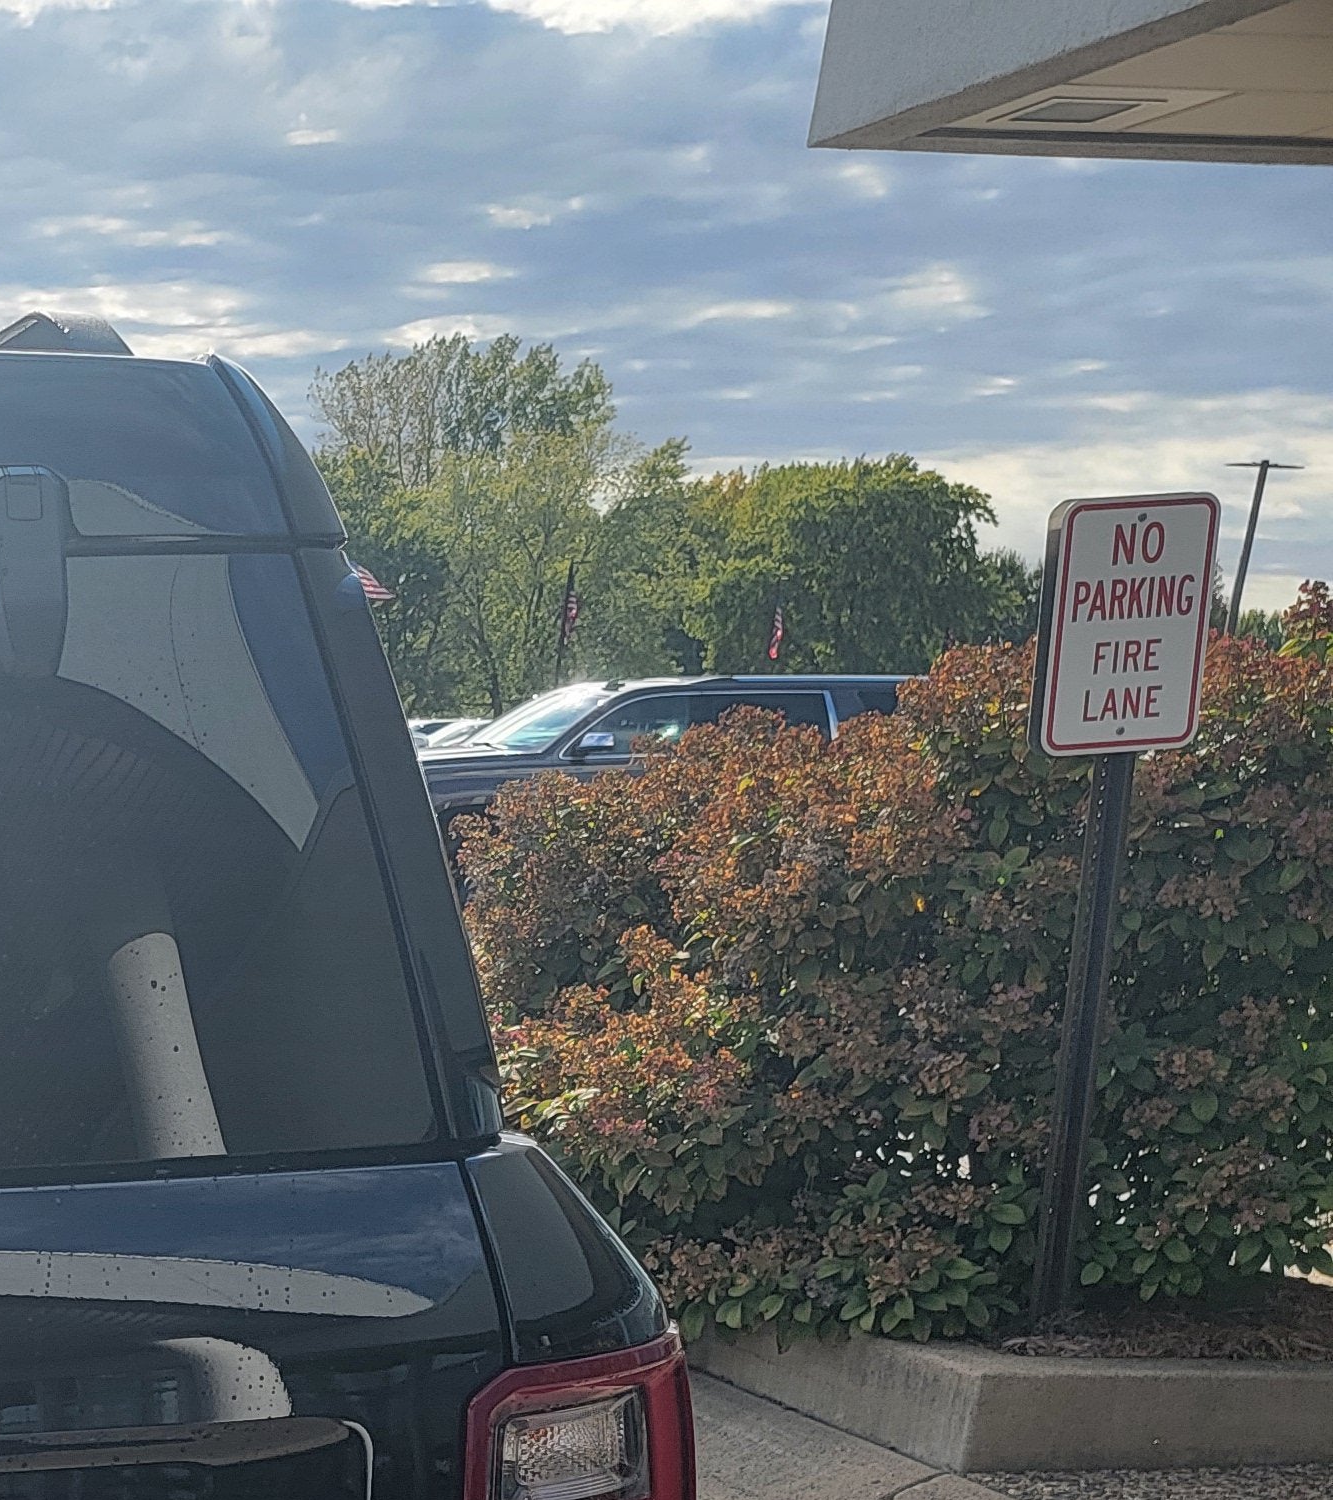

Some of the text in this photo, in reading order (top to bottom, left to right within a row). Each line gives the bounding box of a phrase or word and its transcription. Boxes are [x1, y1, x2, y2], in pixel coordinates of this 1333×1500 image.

[1112, 522, 1165, 566] NO
[1071, 574, 1195, 623] PARKING
[1093, 638, 1162, 675] FIRE
[1083, 685, 1163, 723] LANE
